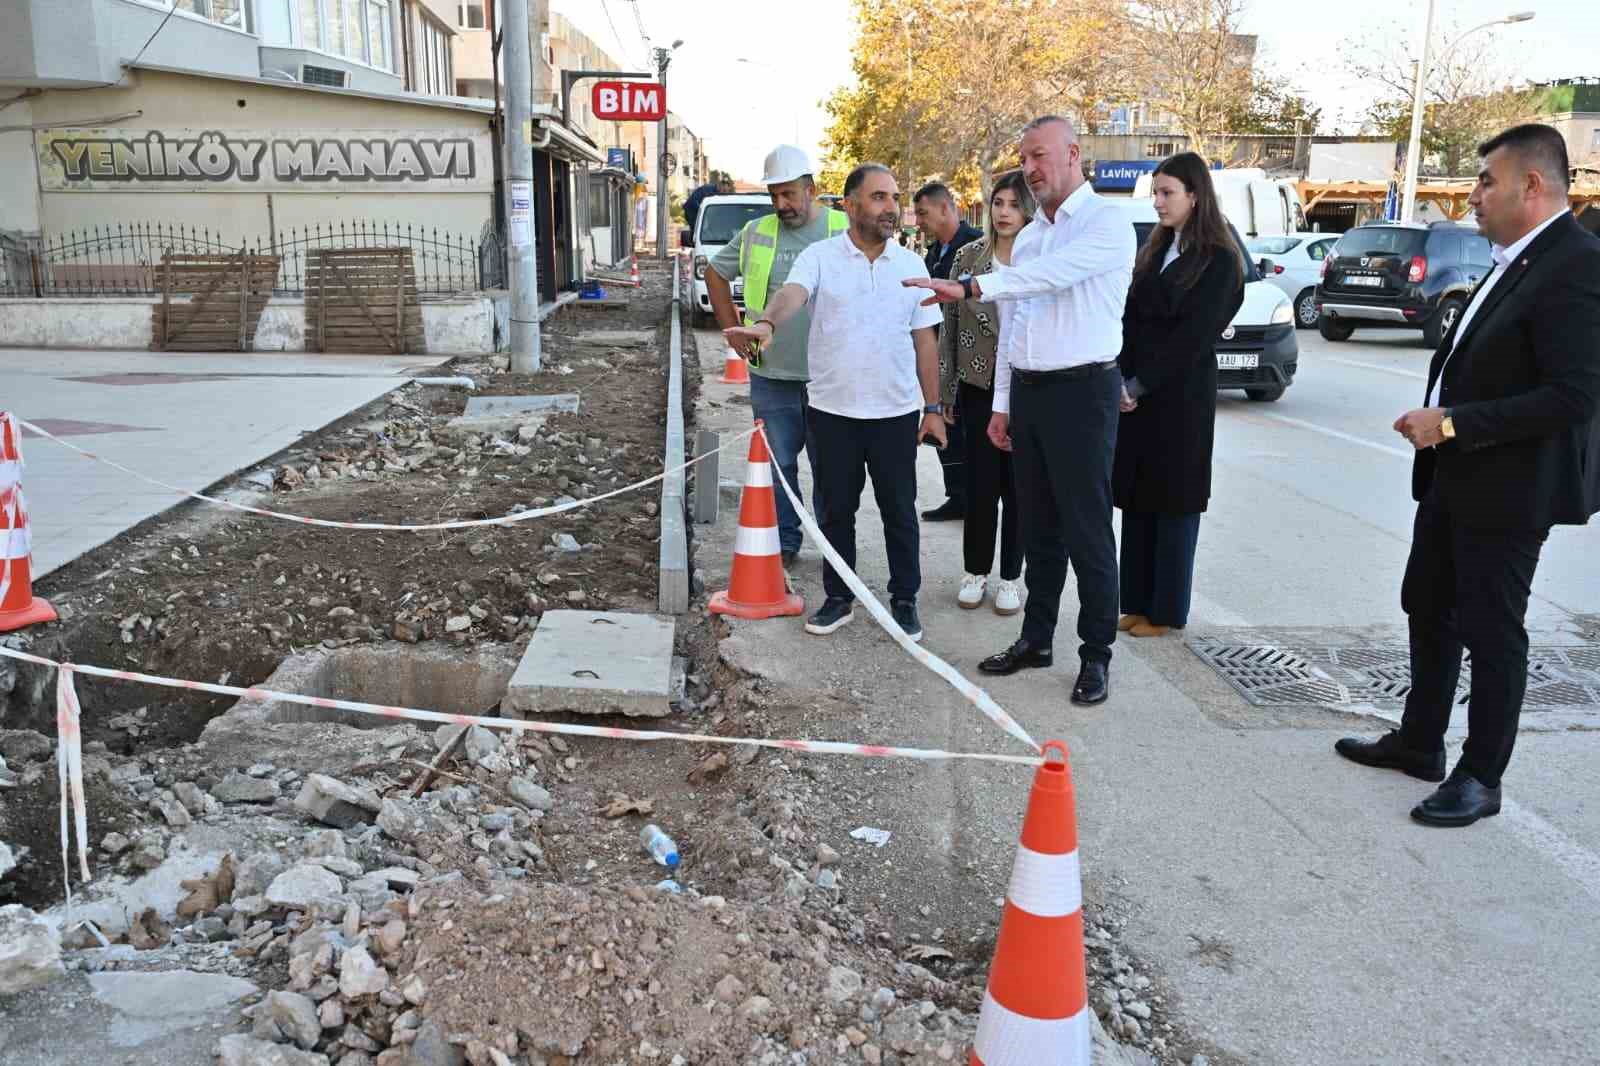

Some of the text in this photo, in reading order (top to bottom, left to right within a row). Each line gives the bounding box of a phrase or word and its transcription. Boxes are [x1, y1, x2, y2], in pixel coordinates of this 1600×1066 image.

[599, 83, 659, 113] BİM
[51, 131, 474, 181] YENİKÖY MANAVI
